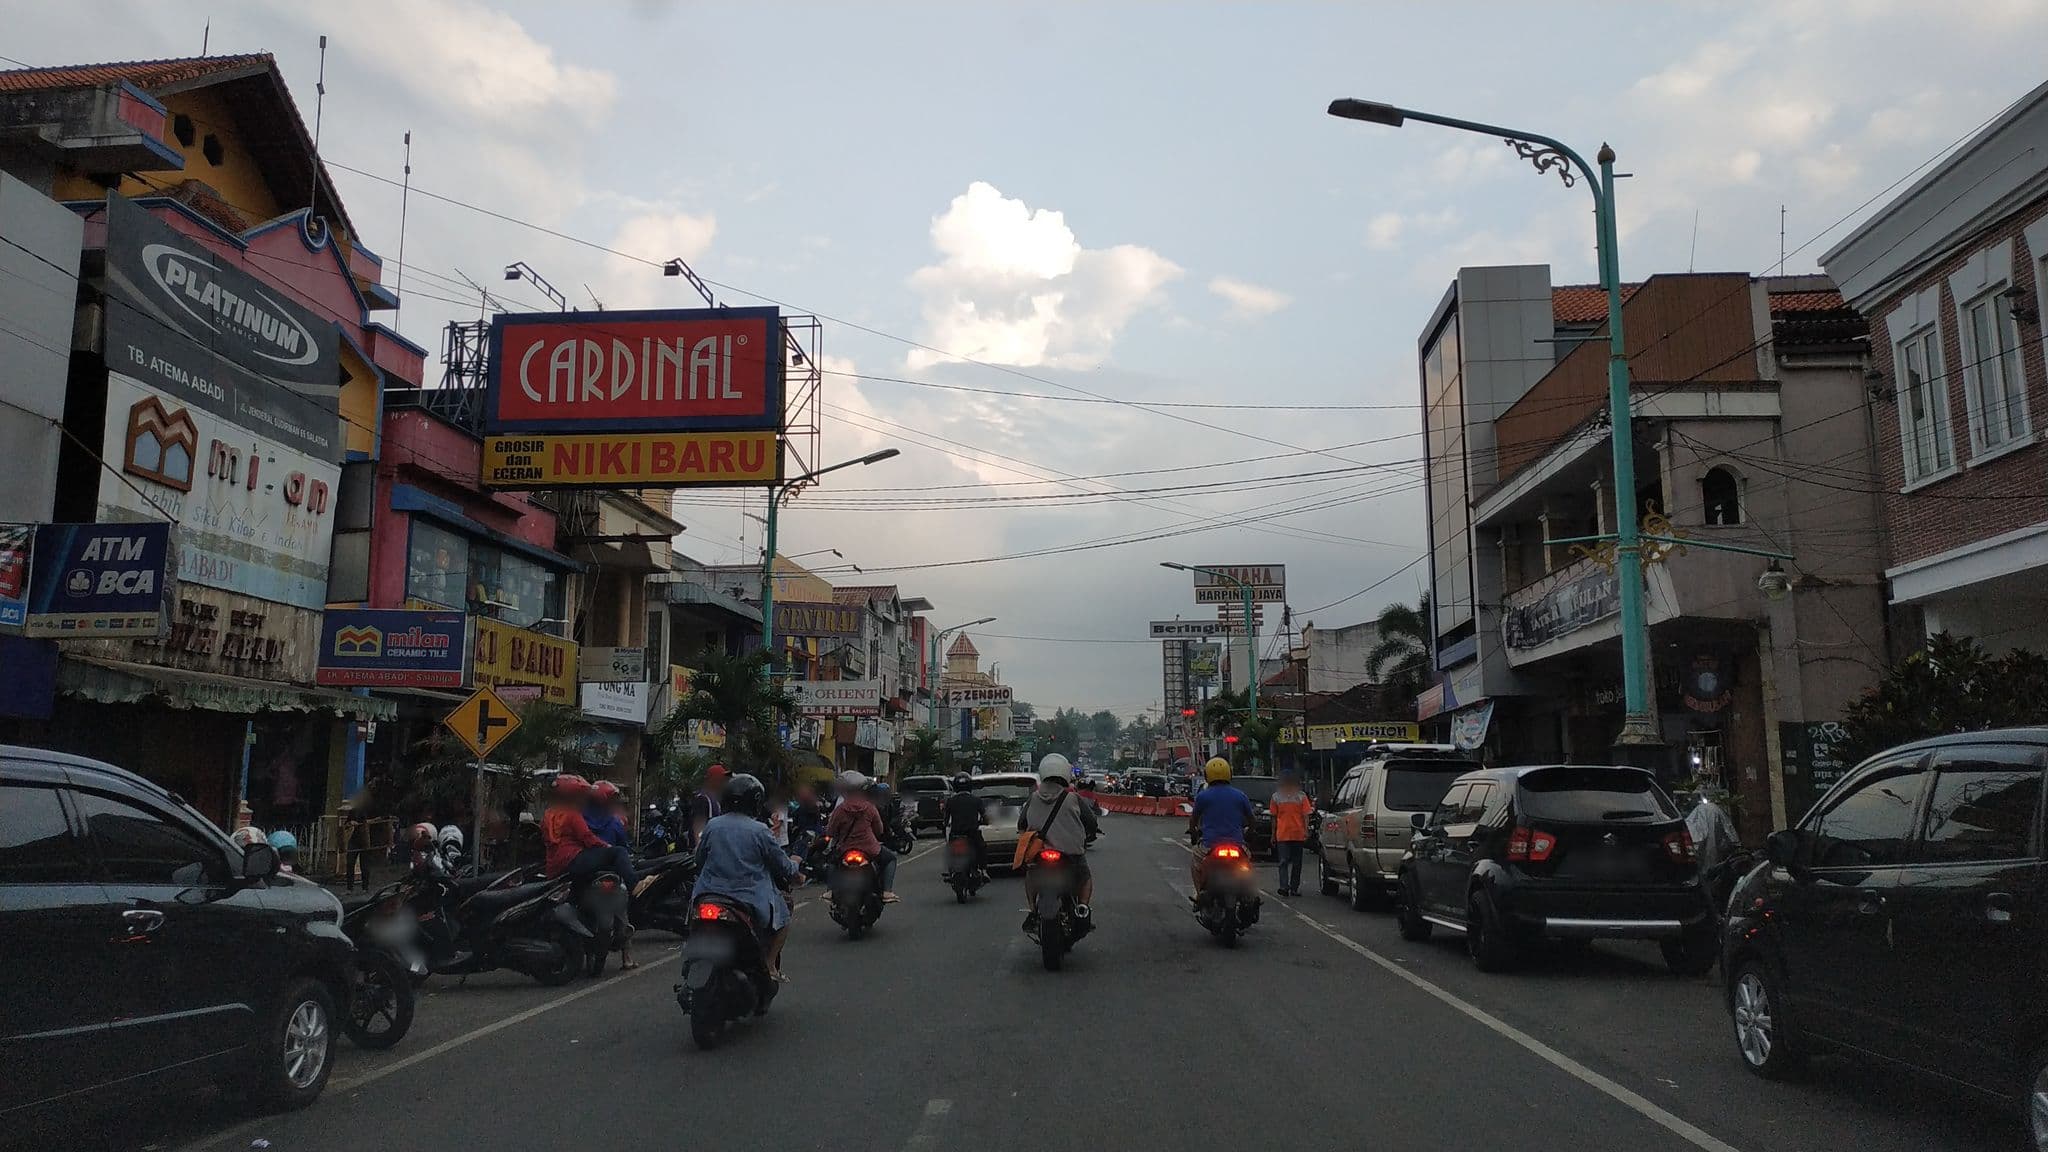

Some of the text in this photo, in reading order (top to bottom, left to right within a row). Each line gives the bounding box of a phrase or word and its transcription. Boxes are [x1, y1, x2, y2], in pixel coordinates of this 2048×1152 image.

[165, 257, 300, 354] PLATINUM
[128, 345, 225, 403] TB. ATEMA ABADI
[519, 335, 743, 403] CARDINAL
[494, 440, 544, 453] GROSIR
[505, 453, 532, 467] dan
[552, 439, 766, 476] NIKI BARU
[493, 467, 543, 481] ECERAN
[80, 536, 147, 561] ATM
[96, 569, 155, 595] BCA
[1207, 567, 1273, 585] YAMAHA
[1258, 588, 1283, 600] JAYA
[777, 607, 859, 632] CENTRAL
[387, 626, 450, 648] milan
[387, 648, 448, 658] CERAMIC TILE
[510, 636, 564, 678] BARU
[814, 688, 877, 699] ORIENT
[964, 689, 1009, 700] ZENSHO
[1352, 725, 1408, 739] FUSION
